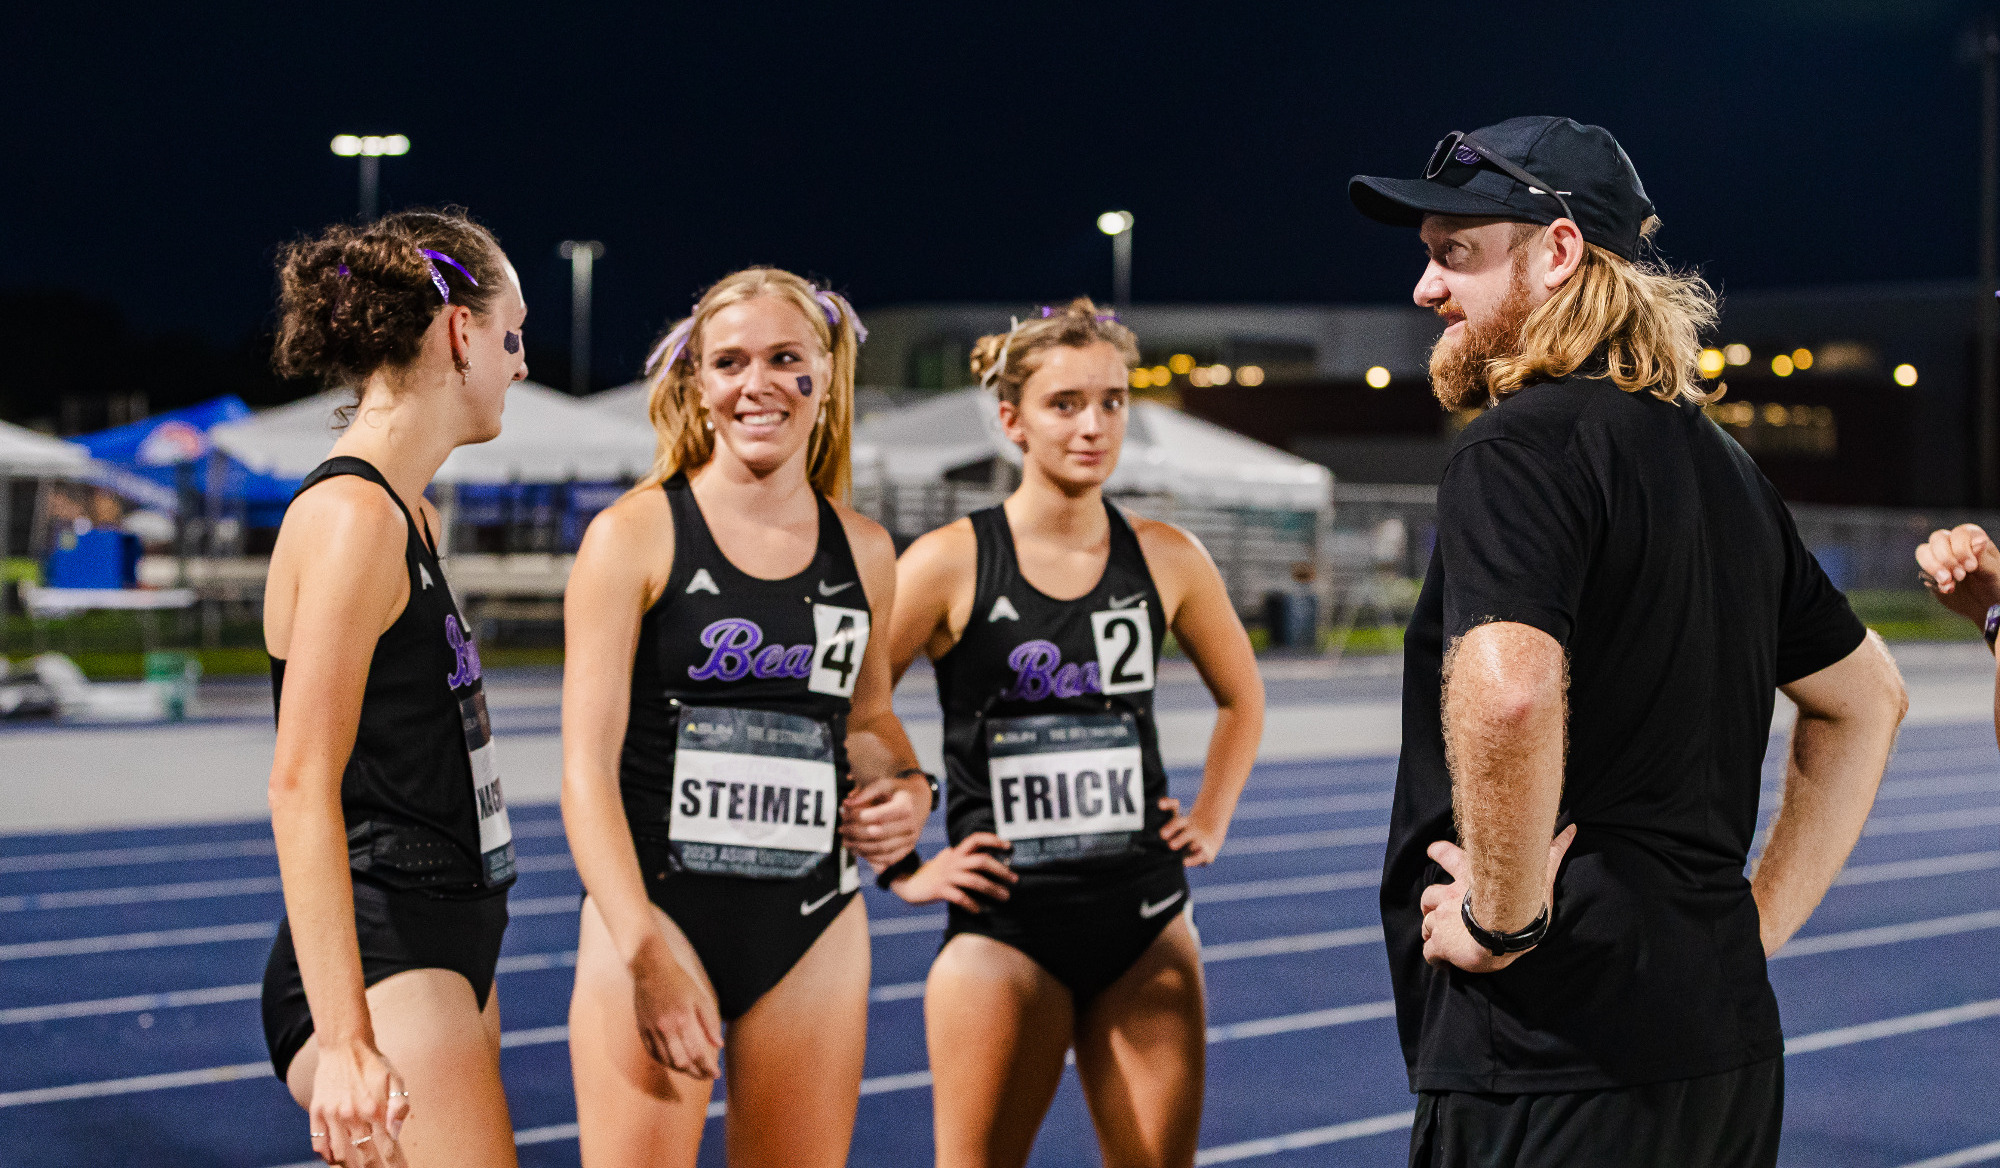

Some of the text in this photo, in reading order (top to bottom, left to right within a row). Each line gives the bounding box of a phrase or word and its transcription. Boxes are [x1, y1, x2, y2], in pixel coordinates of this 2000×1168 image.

[688, 617, 814, 682] Bea
[822, 615, 854, 689] 4
[1007, 639, 1103, 699] Bea
[1103, 617, 1144, 685] 2
[680, 779, 826, 828] STEIMEL
[1000, 767, 1136, 824] FRICK
